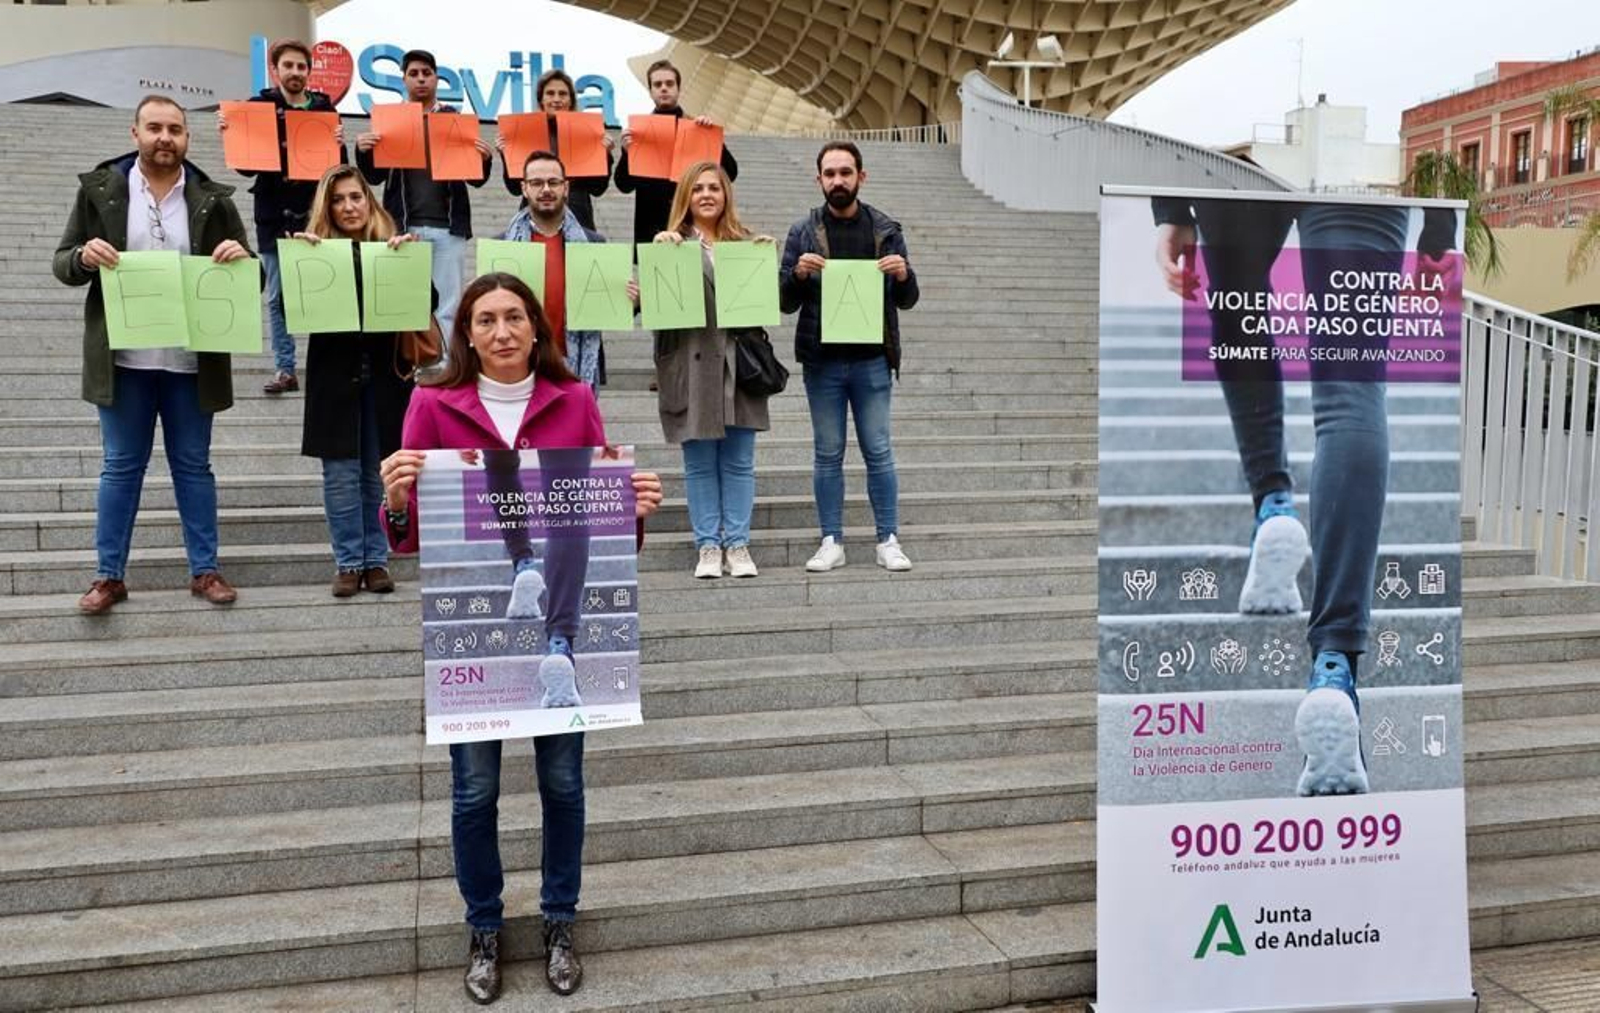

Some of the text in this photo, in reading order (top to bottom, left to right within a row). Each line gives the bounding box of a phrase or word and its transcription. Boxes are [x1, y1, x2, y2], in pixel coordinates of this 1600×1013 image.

[139, 78, 174, 90] PLAZA
[1329, 270, 1445, 292] CONTRA LA
[1204, 291, 1445, 317] VIOLENCIA DE GÉNERO,
[1241, 315, 1445, 337] CADA PASO CUENTA
[1208, 343, 1446, 362] SÚMATE PARA SEGUIR AVANZANDO
[552, 477, 624, 489] CONTRA LA
[476, 492, 546, 504] VIOLENCIA
[549, 491, 566, 501] DE
[499, 502, 624, 516] CADA PASO CUENTA
[481, 516, 625, 530] SÚMATE PARA SEGUIR AVANZANDO
[440, 665, 484, 685] 25N
[442, 719, 511, 732] 900 200 999
[1132, 702, 1206, 737] 25N
[1157, 742, 1240, 758] Internacional
[1243, 741, 1282, 754] contra
[1133, 763, 1145, 776] la
[1148, 761, 1207, 776] Violencia
[1210, 761, 1226, 774] de
[1171, 813, 1402, 858] 900 200 999
[1171, 861, 1220, 873] Teléfono
[1224, 859, 1266, 871] andaluz
[1269, 859, 1290, 869] que
[1294, 857, 1326, 869] ayuda
[1340, 855, 1356, 865] las
[1359, 852, 1401, 864] mujeres
[1254, 906, 1312, 925] Junta
[1254, 923, 1381, 950] de Andalucía
